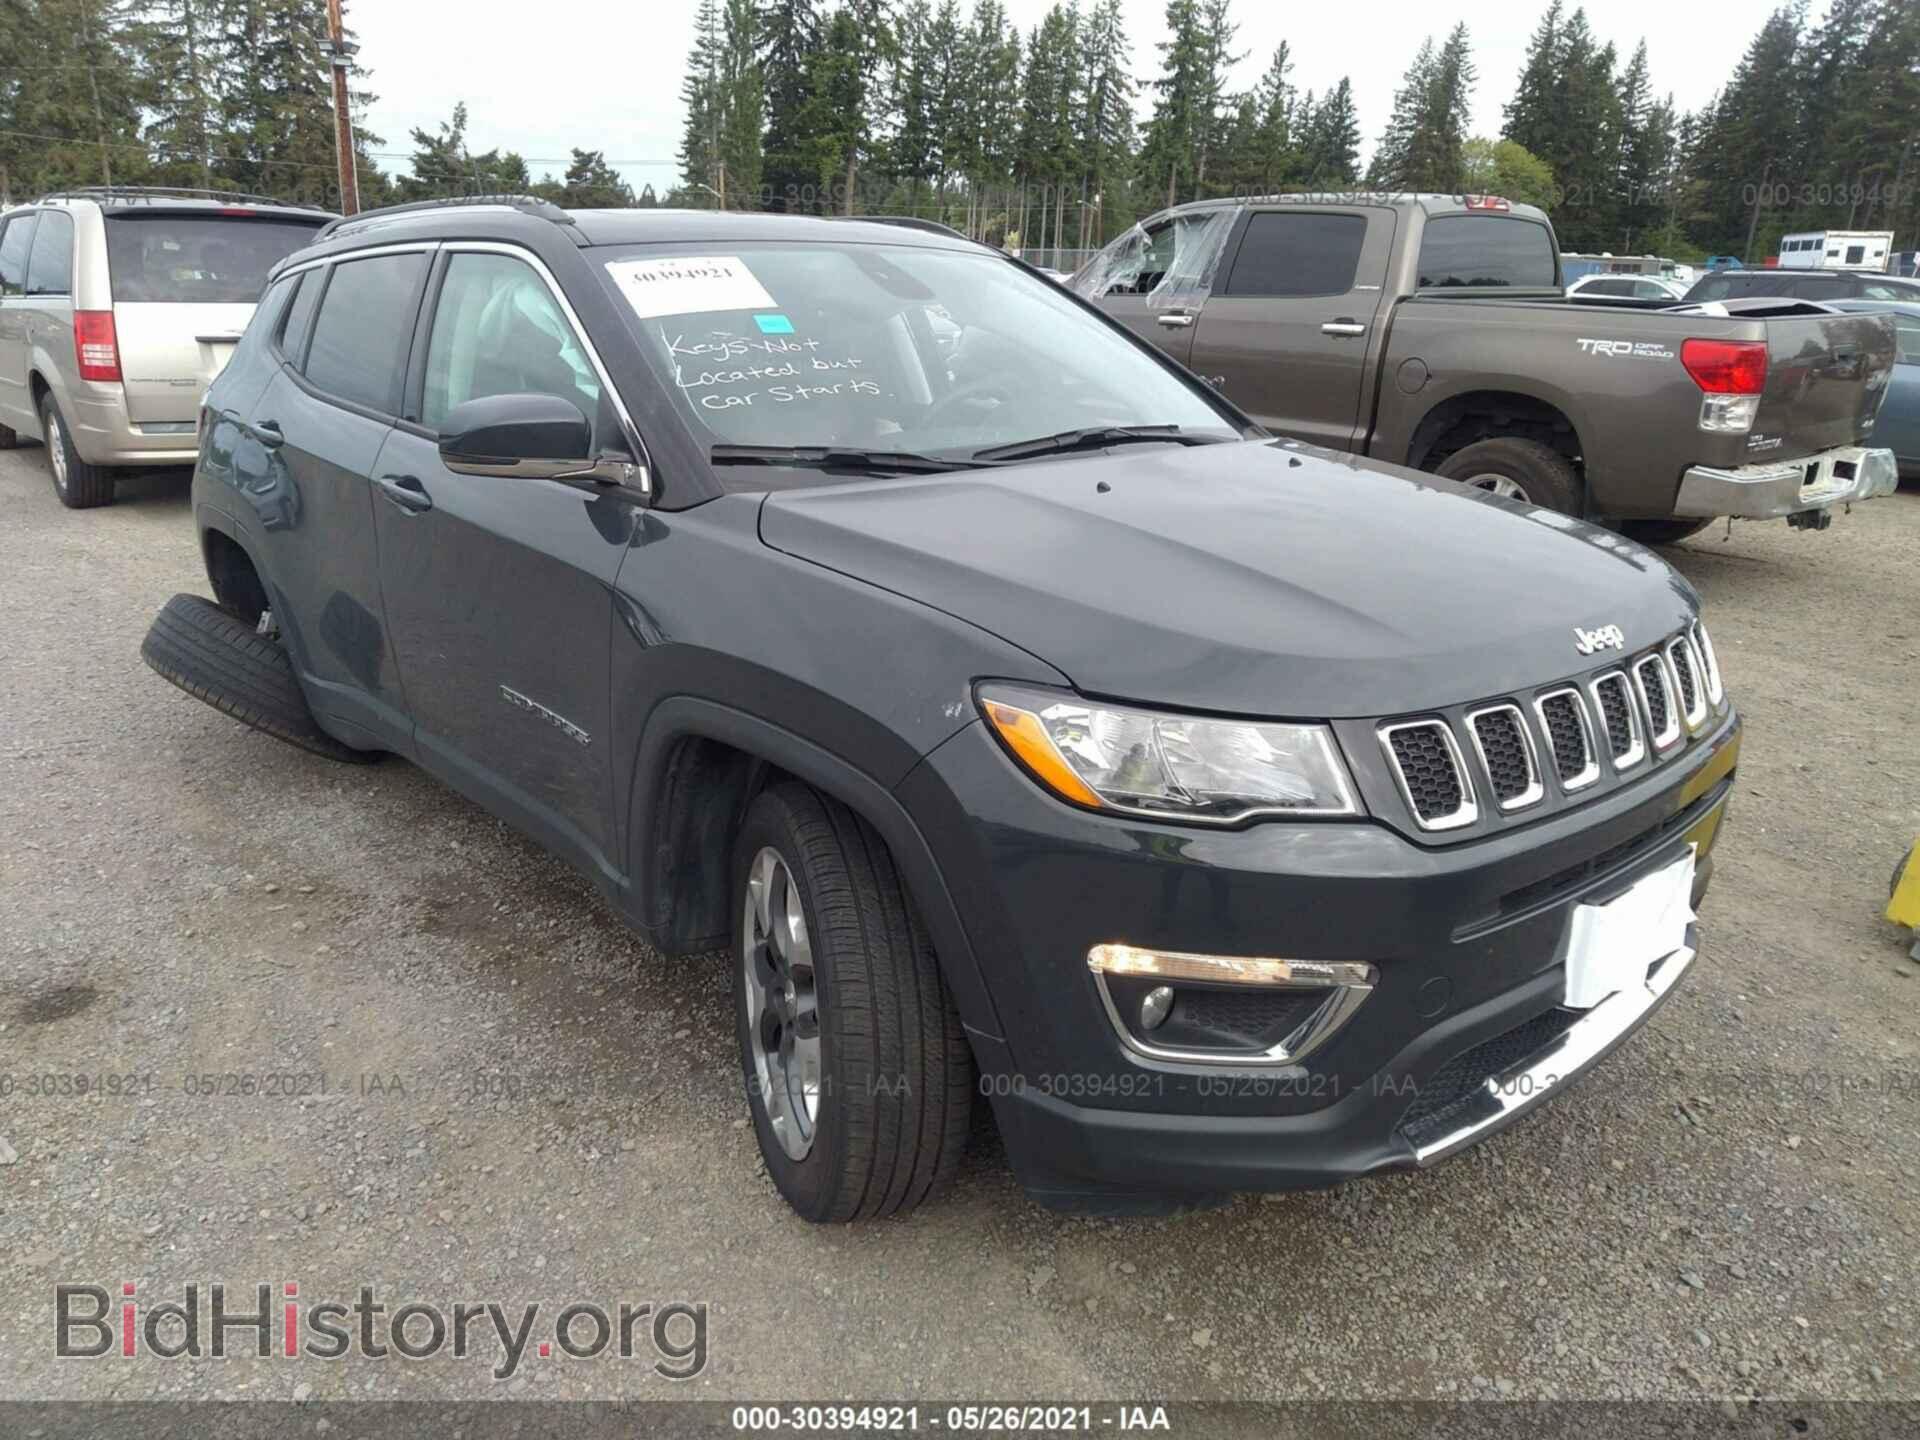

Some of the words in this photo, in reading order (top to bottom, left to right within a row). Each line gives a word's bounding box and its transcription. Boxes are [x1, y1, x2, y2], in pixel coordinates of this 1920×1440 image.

[676, 364, 801, 387] Located
[811, 357, 862, 369] but
[1572, 624, 1625, 654] Jeep
